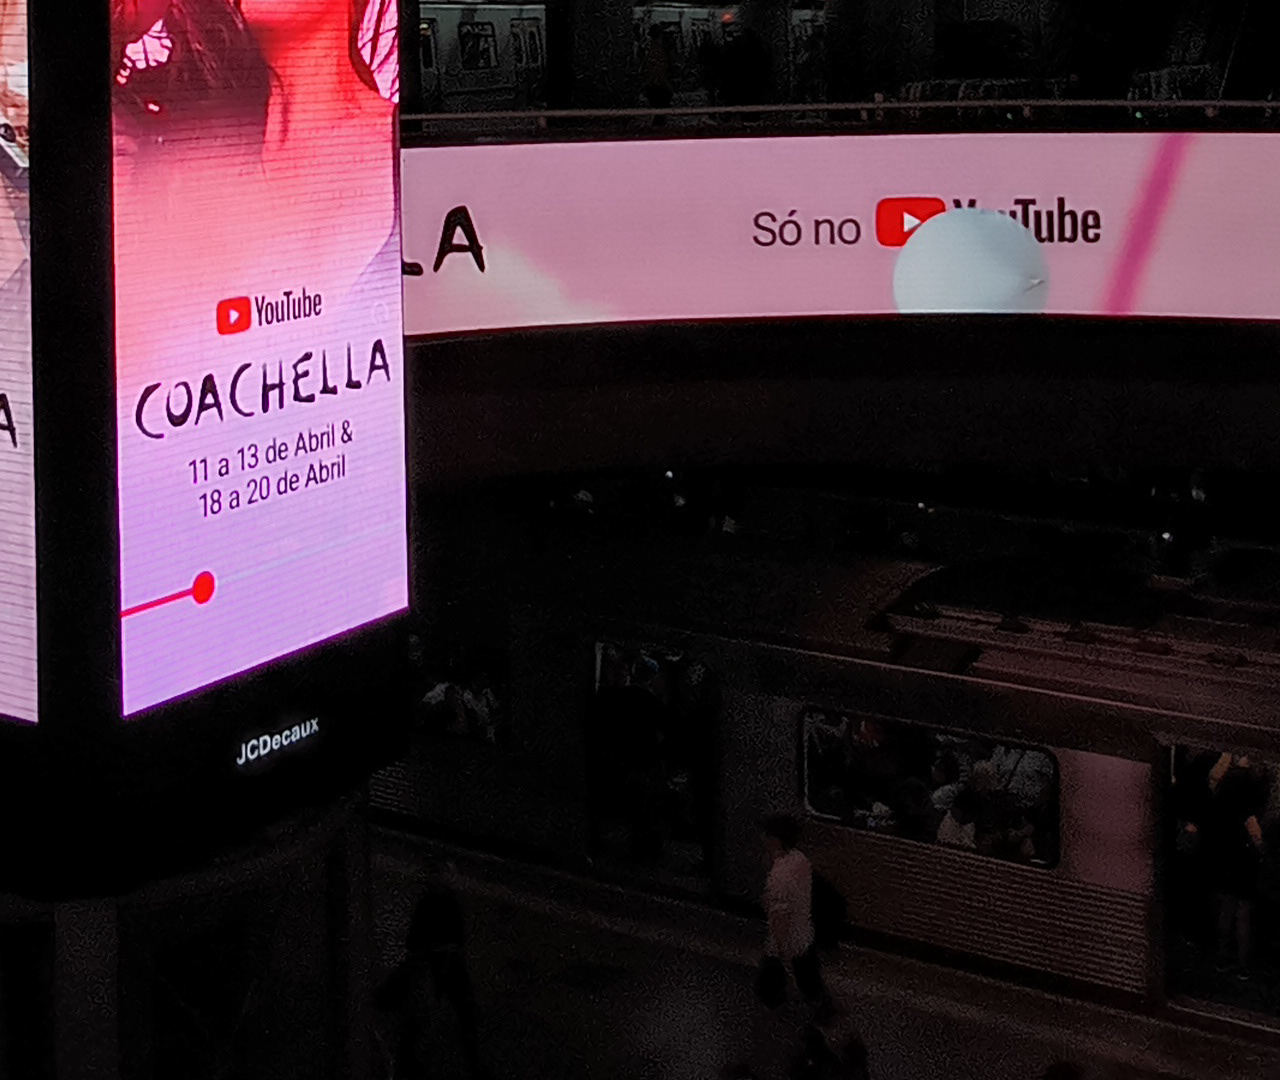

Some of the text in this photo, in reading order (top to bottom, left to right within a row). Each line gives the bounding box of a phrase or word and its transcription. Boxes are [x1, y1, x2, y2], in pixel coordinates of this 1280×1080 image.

[753, 211, 801, 247] Só
[814, 218, 861, 245] no
[255, 287, 322, 326] YouTube
[135, 339, 390, 439] COACHELLA
[189, 420, 353, 484] 11 a 13 de Abril &
[199, 455, 346, 517] 18 a 20 de Abril
[236, 716, 320, 765] JCDecaux
